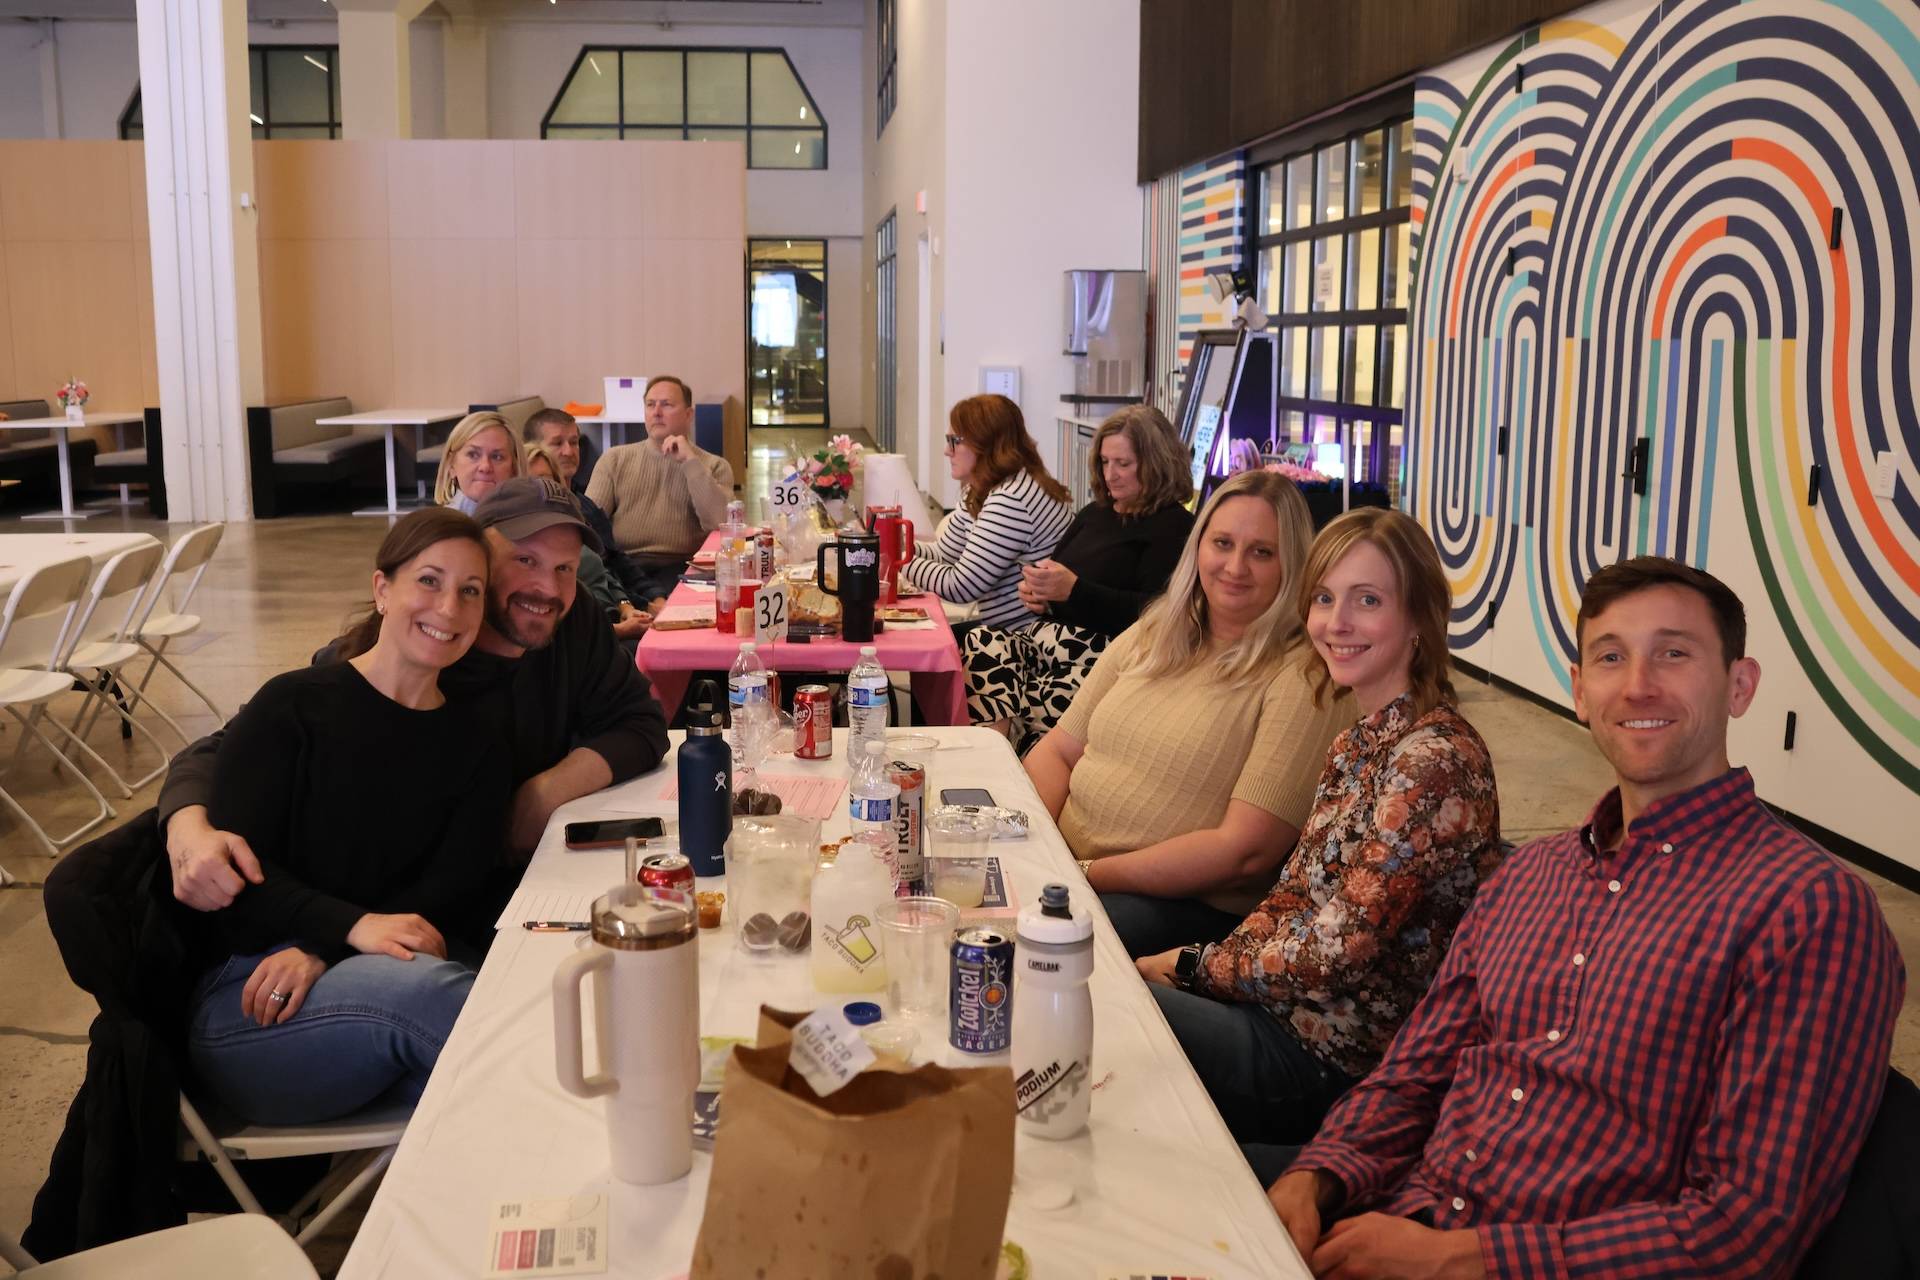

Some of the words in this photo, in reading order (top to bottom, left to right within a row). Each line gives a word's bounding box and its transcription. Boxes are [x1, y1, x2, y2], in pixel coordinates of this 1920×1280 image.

[774, 486, 799, 506] 36
[761, 550, 770, 579] TRULY
[759, 591, 785, 629] 32
[821, 932, 839, 950] TACO
[838, 949, 865, 974] BUDDHA
[1028, 959, 1059, 973] CAMELBAK
[958, 968, 980, 1032] Zwickel
[799, 1024, 849, 1079] BUDDHA
[820, 1023, 853, 1062] TACO
[957, 1038, 1006, 1050] LAGER
[1017, 1061, 1061, 1101] PODIUM
